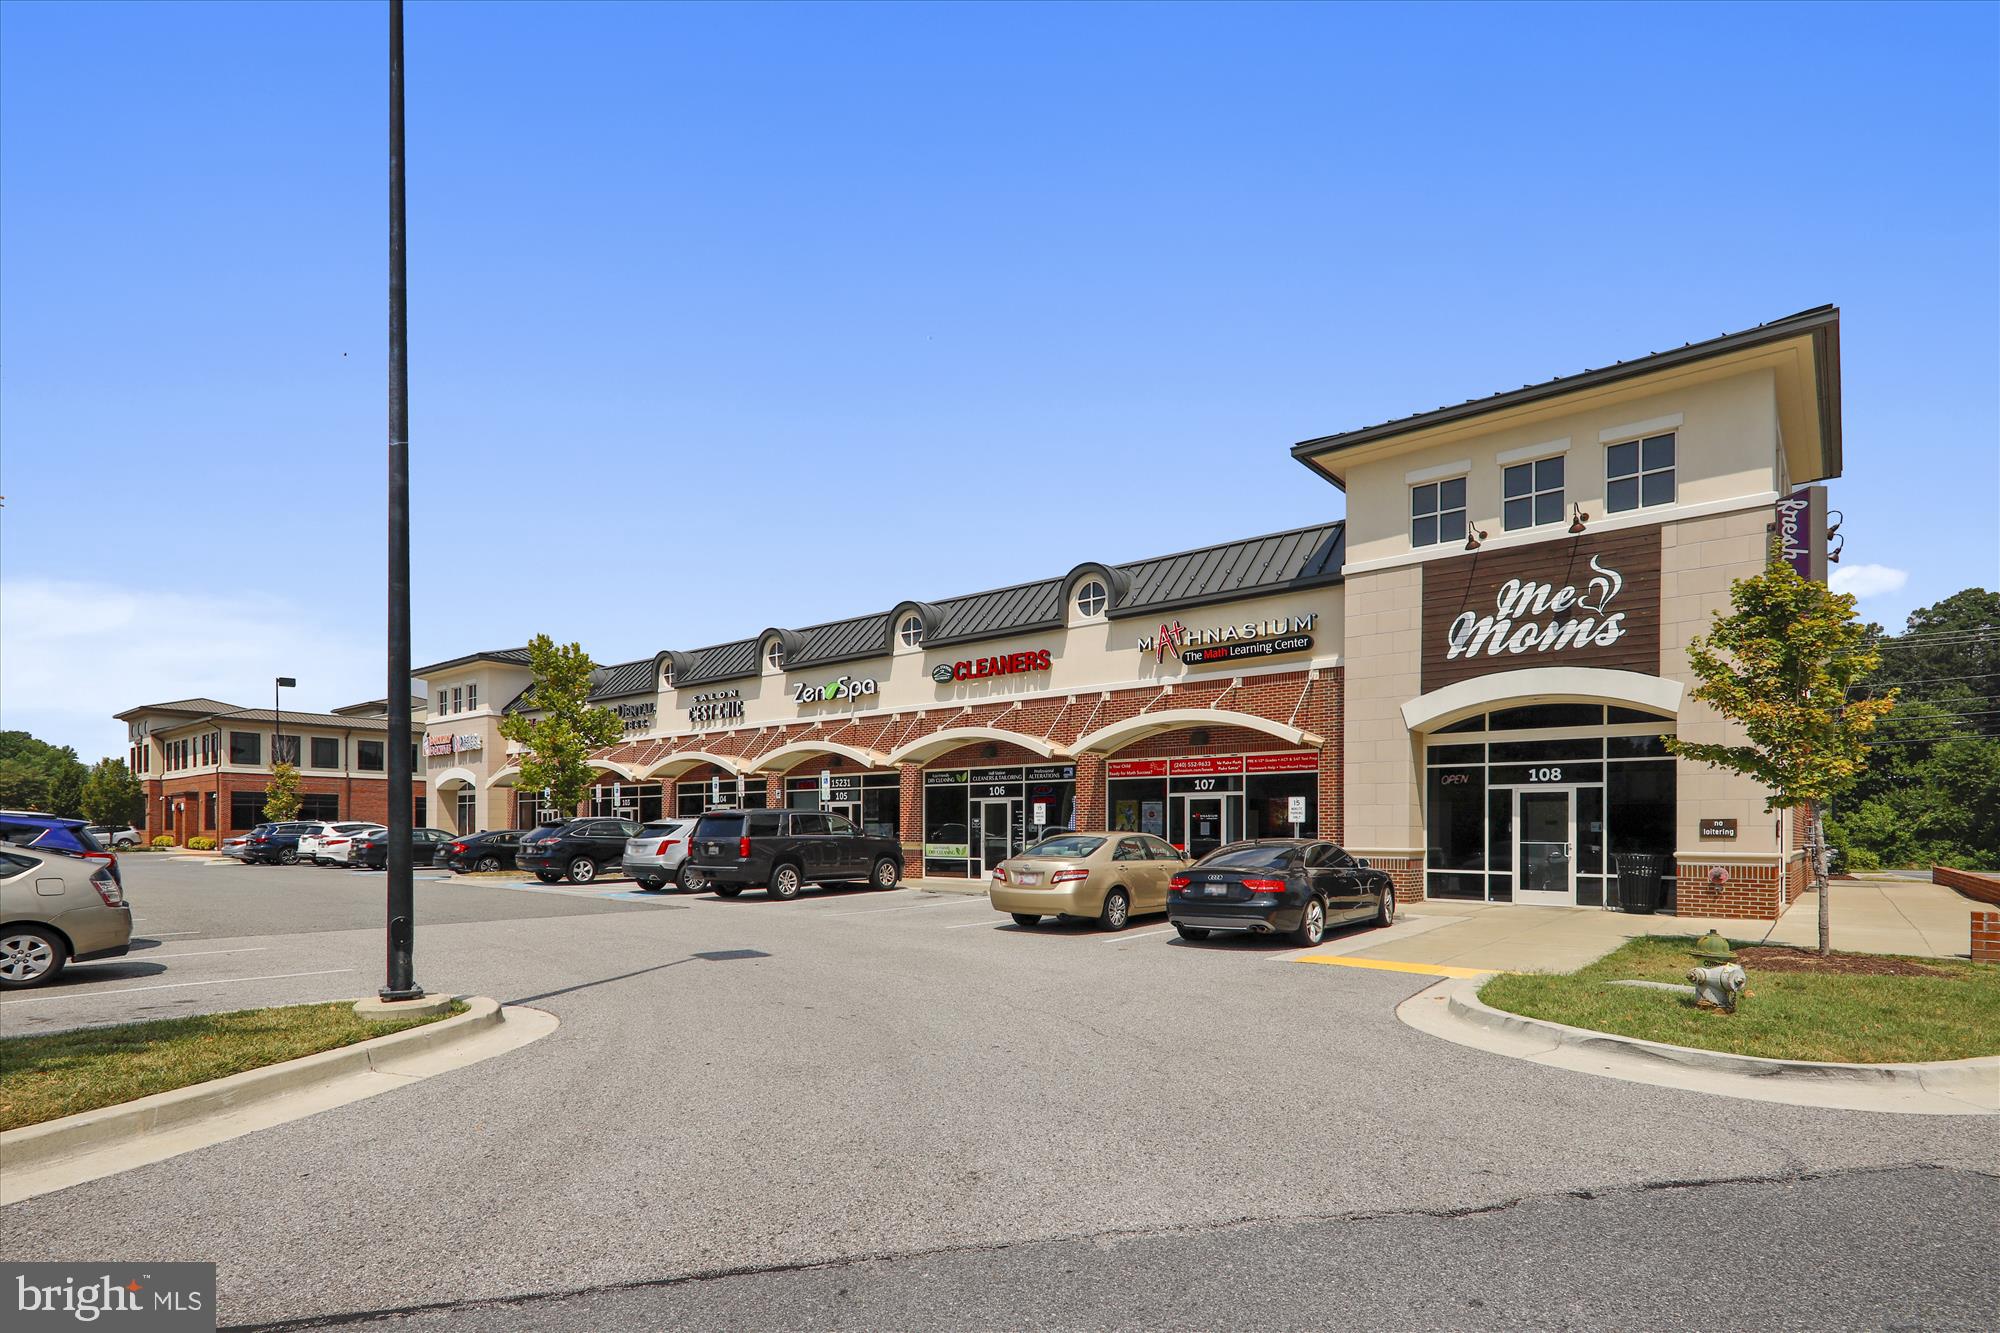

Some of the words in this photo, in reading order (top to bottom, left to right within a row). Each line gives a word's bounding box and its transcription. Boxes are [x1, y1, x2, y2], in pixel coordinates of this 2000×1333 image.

[1496, 578, 1577, 621] Me
[1446, 611, 1627, 660] Moms
[1185, 651, 1203, 662] The
[1204, 648, 1229, 660] Math
[1230, 641, 1273, 657] Learning
[1275, 636, 1309, 651] Center
[953, 649, 1052, 682] CLEANERS
[692, 689, 739, 703] SALON
[793, 682, 826, 704] Zen
[837, 676, 878, 703] Spa
[1440, 774, 1470, 785] OPEN
[1528, 767, 1562, 782] 108
[831, 779, 851, 787] 15231
[1194, 779, 1216, 790] 107
[835, 792, 848, 800] 105
[989, 786, 1006, 796] 106
[1703, 828, 1734, 837] loitering
